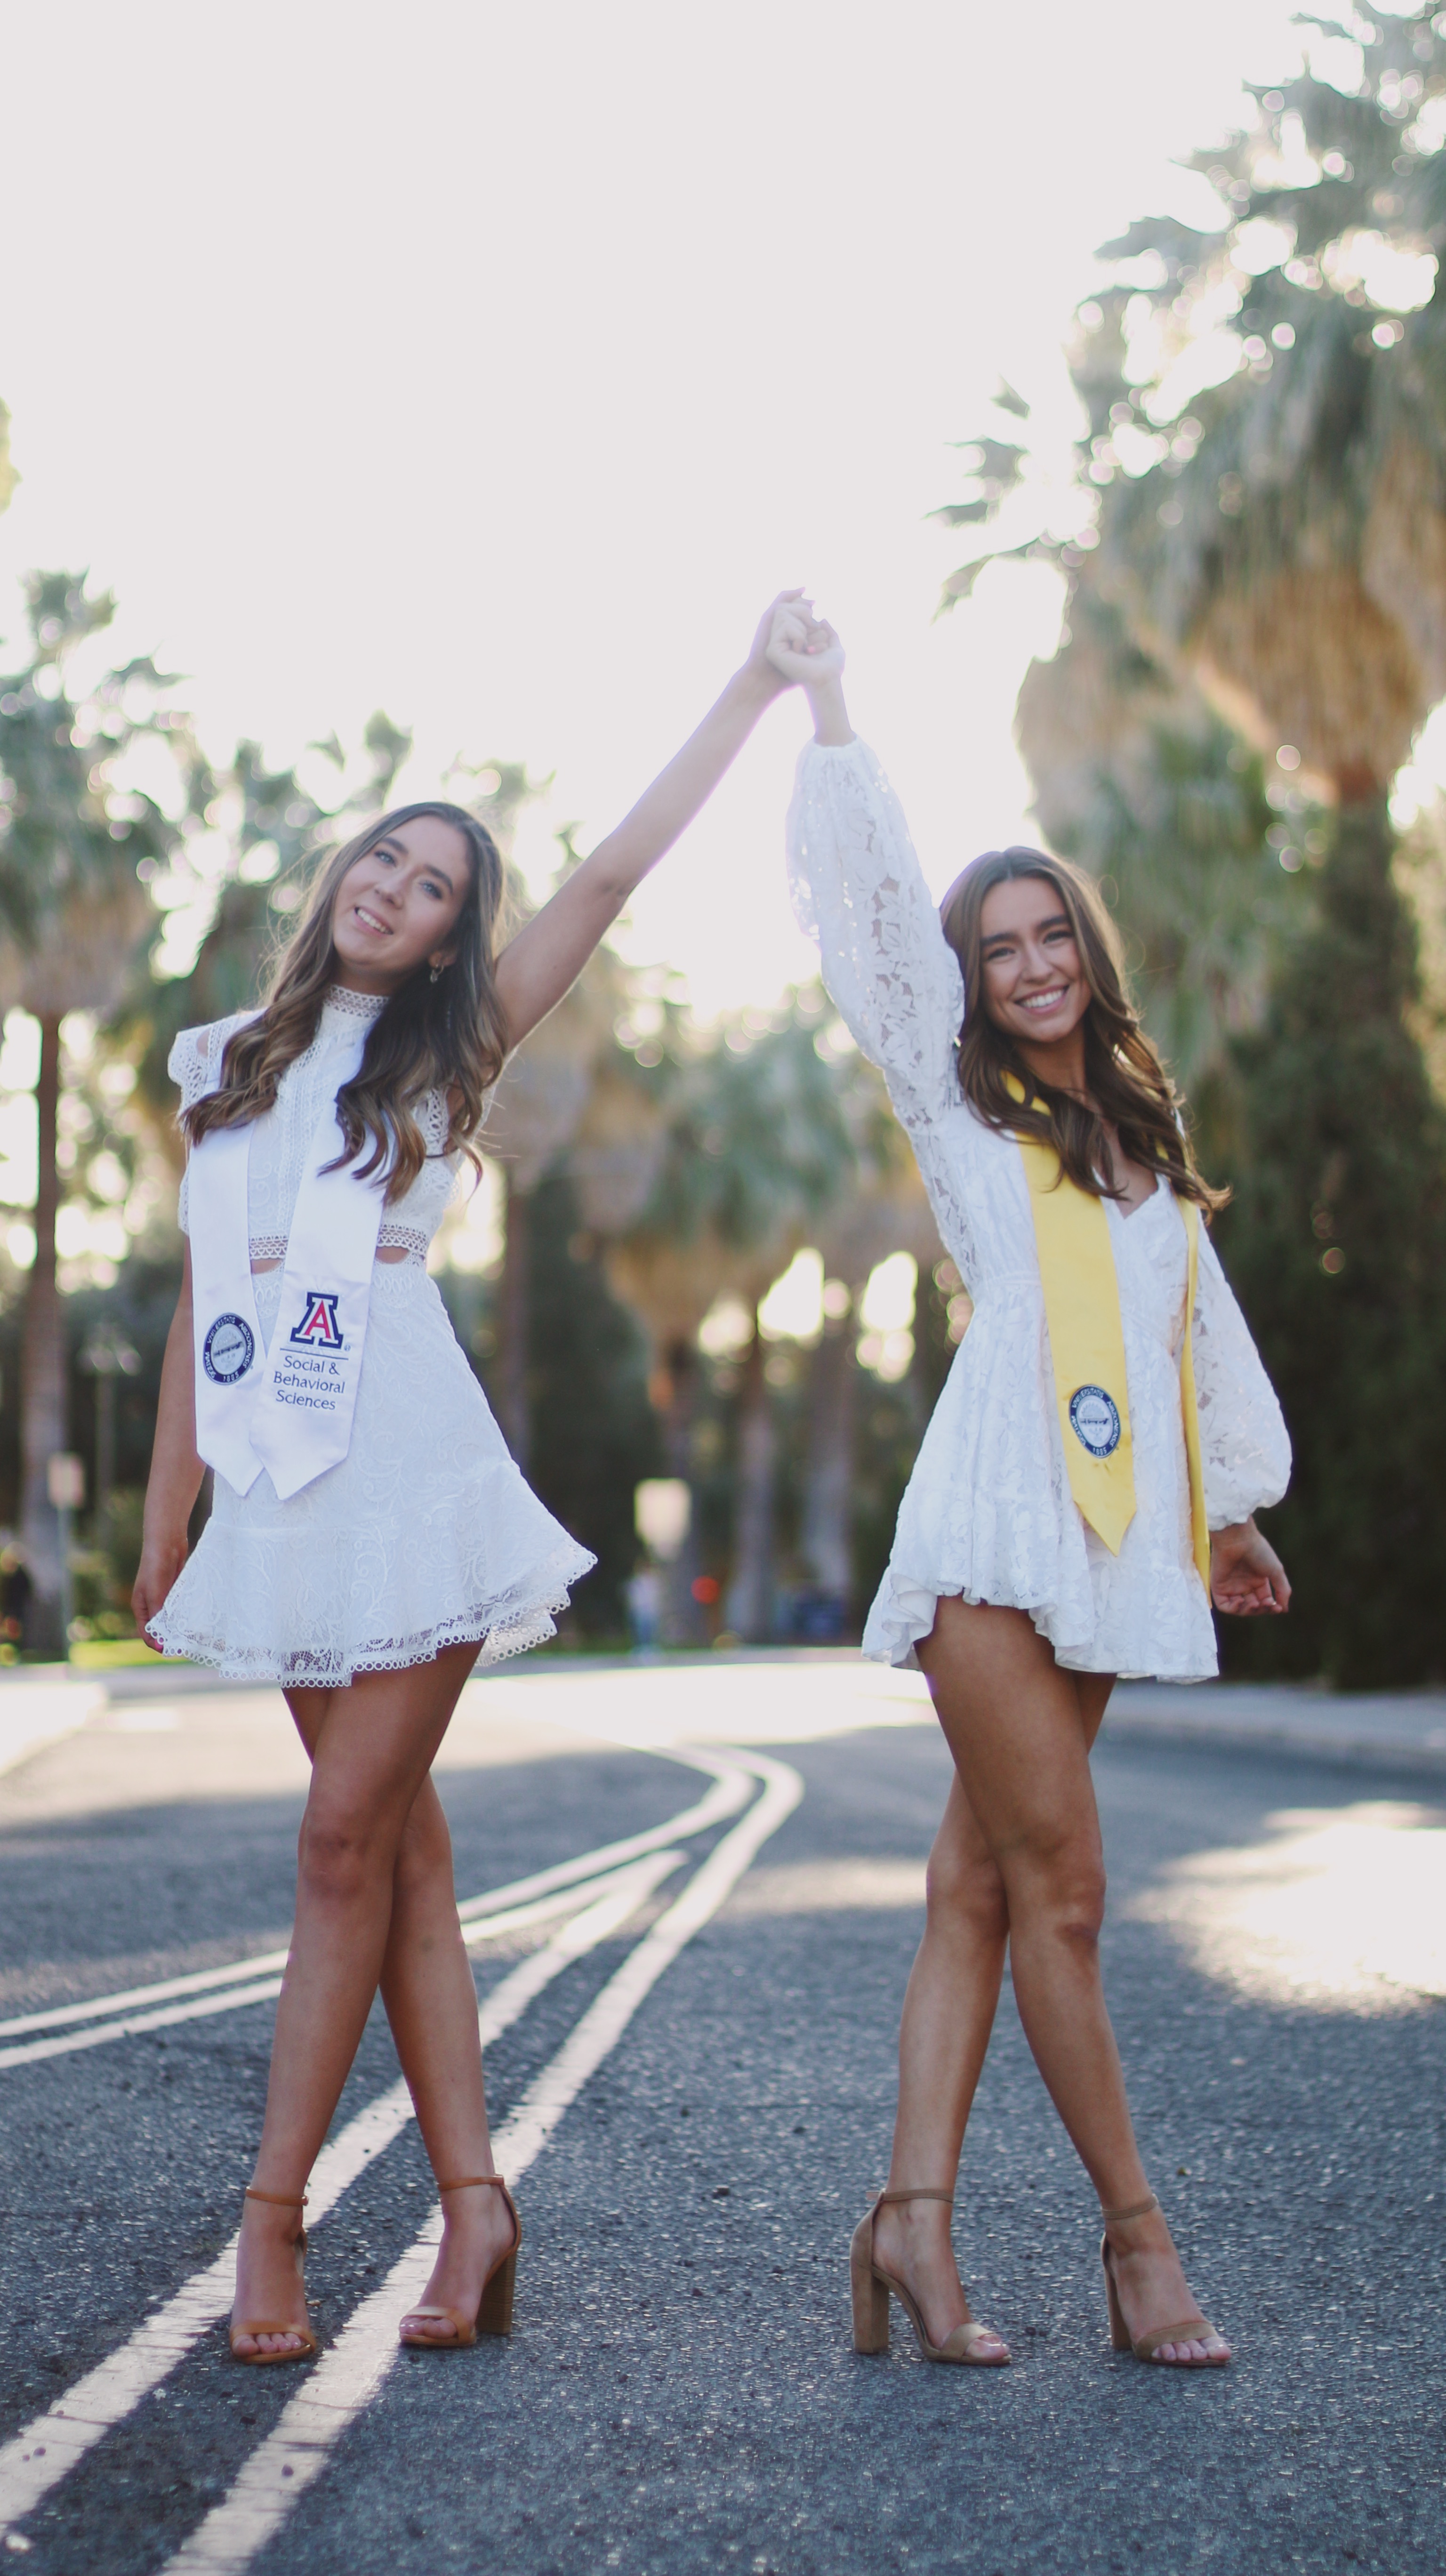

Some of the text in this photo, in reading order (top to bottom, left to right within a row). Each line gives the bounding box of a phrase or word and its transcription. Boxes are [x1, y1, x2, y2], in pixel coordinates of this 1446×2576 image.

[290, 1292, 344, 1349] A
[283, 1355, 340, 1376] Social &
[223, 1372, 240, 1383] 1885
[273, 1371, 345, 1393] Behavioral
[275, 1390, 336, 1410] Sciences
[1093, 1447, 1107, 1456] 1885
